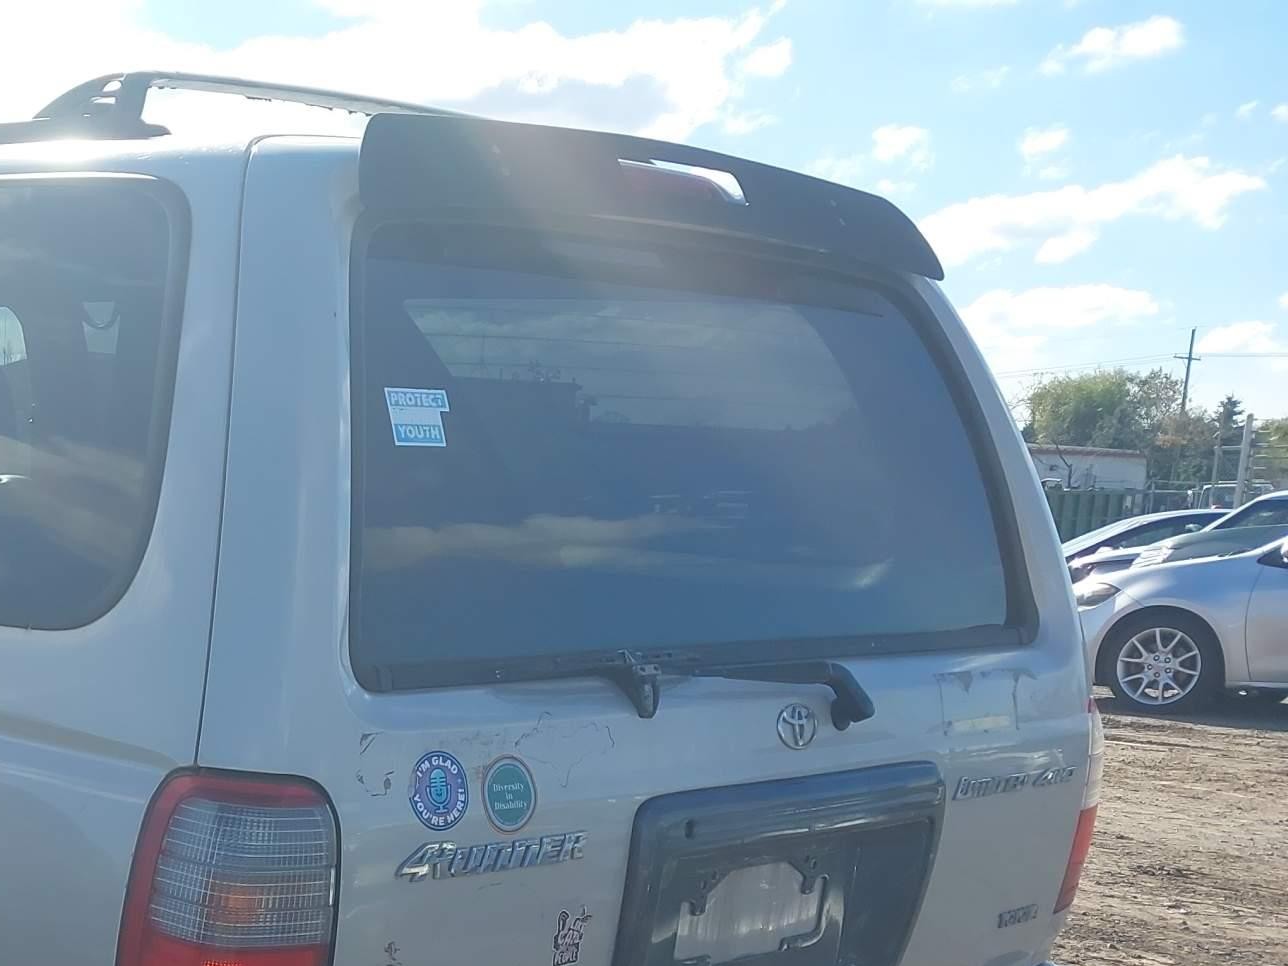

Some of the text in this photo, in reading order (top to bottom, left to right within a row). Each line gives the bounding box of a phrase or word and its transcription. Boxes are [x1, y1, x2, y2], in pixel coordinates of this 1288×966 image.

[390, 391, 443, 407] PROTECT
[398, 424, 441, 440] YOUTH
[416, 756, 458, 778] I'M GLAD
[493, 782, 524, 793] Diversity
[413, 788, 465, 826] YOU'RE HERE!
[494, 800, 527, 811] Disability
